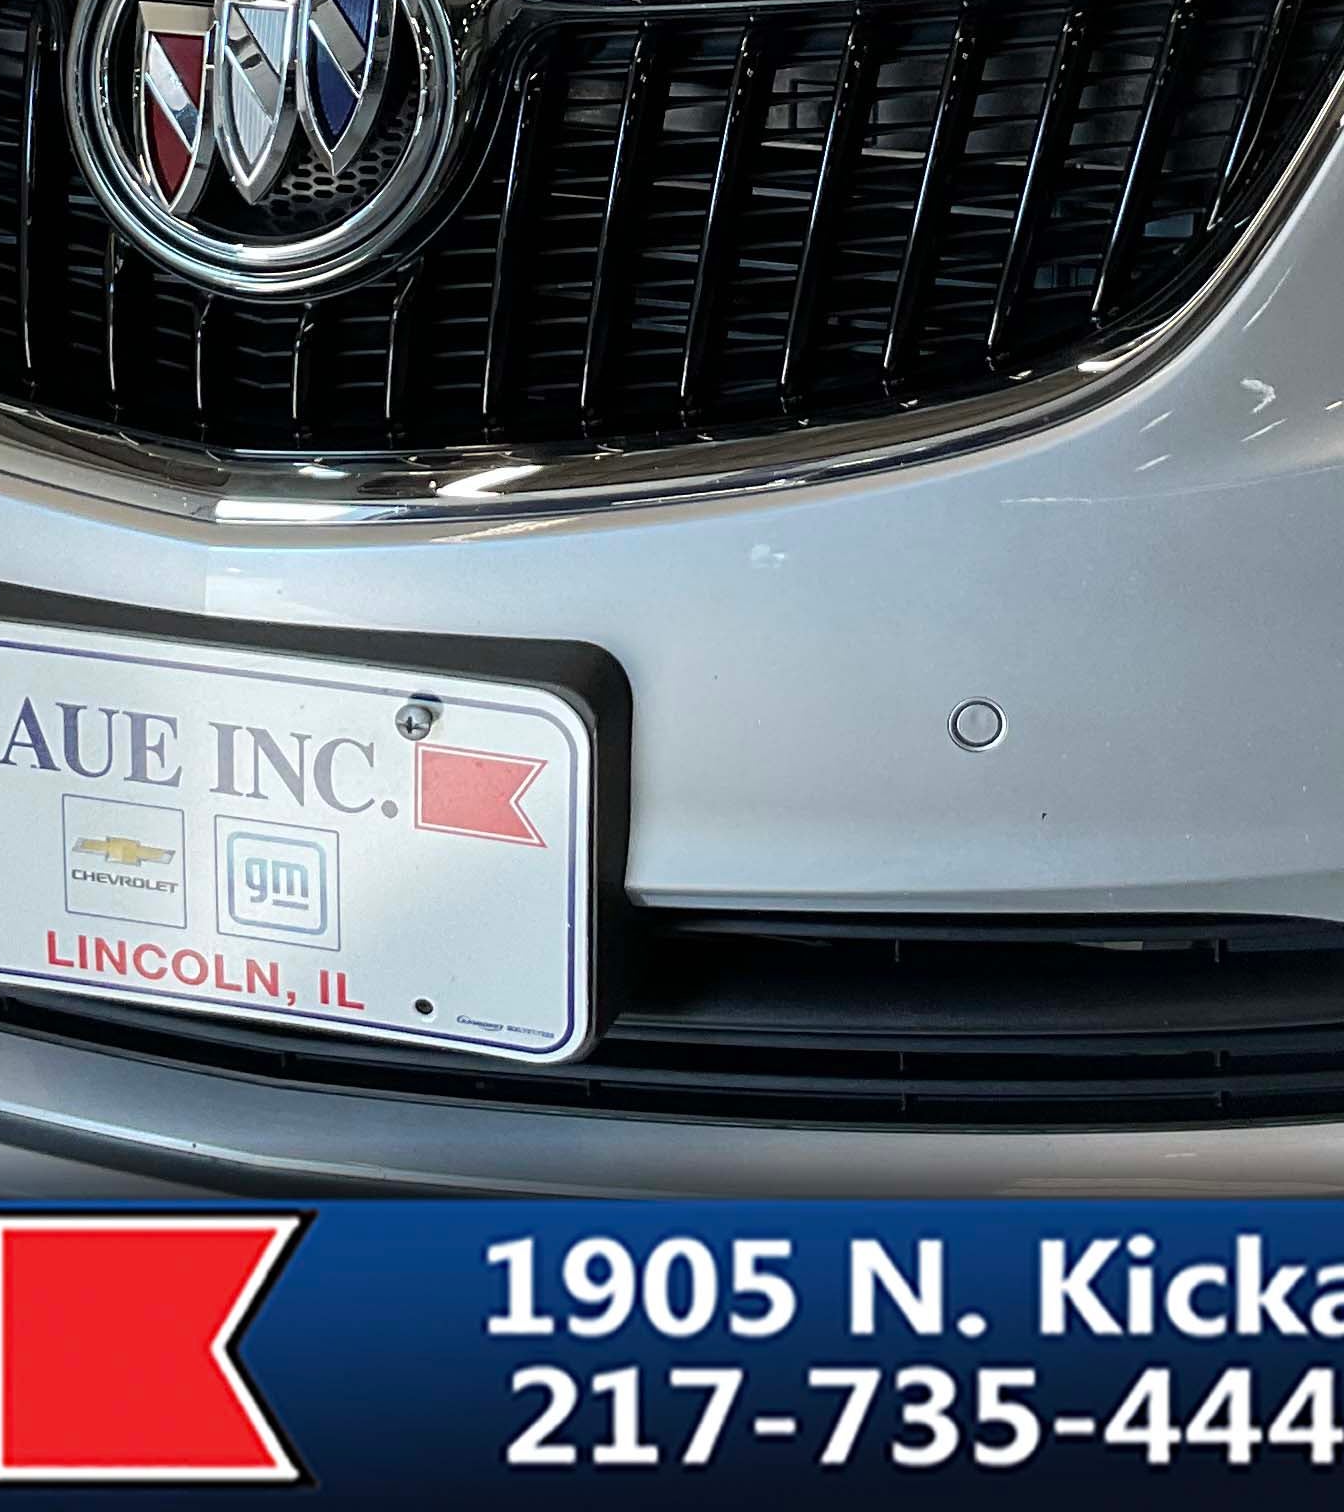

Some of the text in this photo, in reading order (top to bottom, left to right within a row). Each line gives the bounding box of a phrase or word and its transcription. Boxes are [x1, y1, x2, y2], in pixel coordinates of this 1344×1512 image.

[209, 720, 399, 820] INC.
[71, 868, 178, 894] CHEVROLET
[245, 856, 310, 911] gm
[46, 929, 365, 1010] LINCOLN, IL
